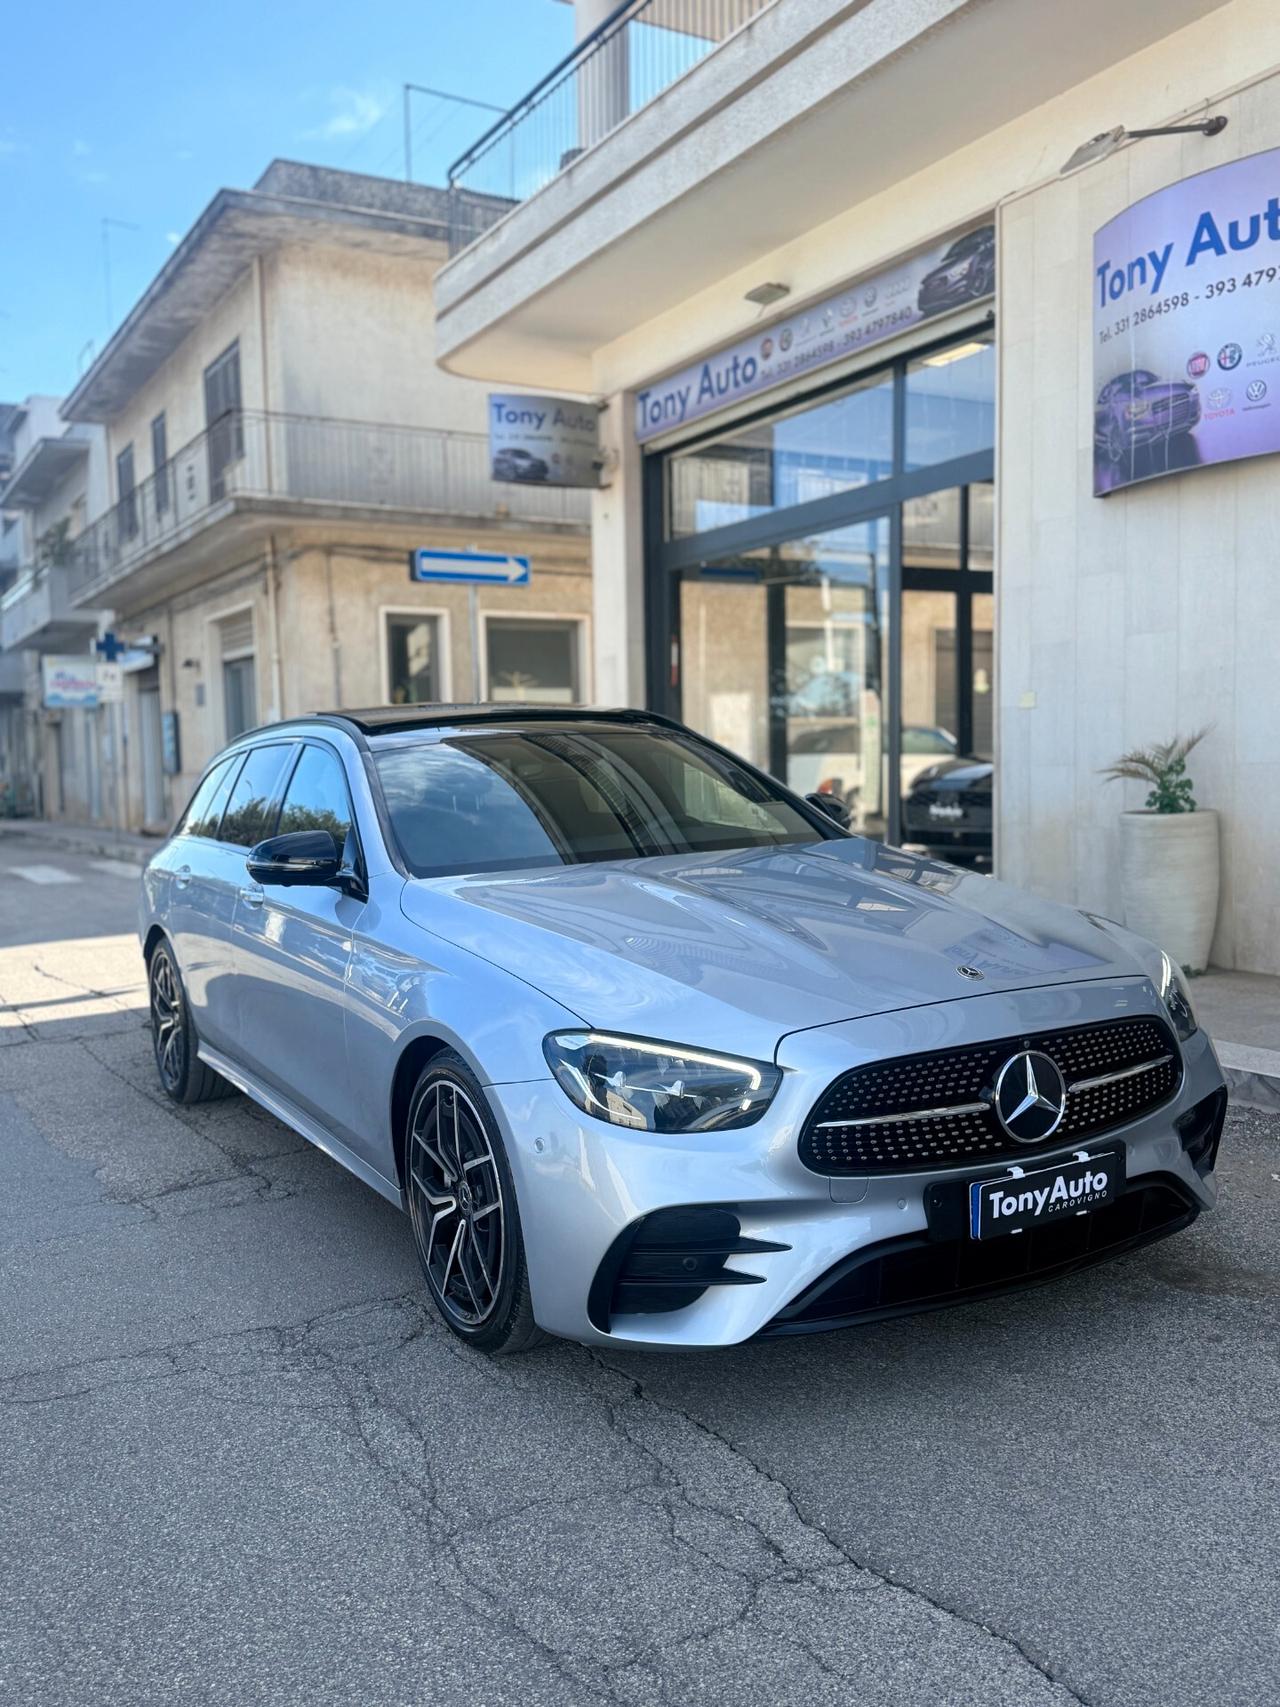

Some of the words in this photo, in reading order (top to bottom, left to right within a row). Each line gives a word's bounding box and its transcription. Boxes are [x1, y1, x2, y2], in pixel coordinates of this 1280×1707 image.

[1097, 242, 1174, 308] Tony
[1114, 316, 1131, 336] 331
[1133, 292, 1189, 327] 2864598
[1205, 278, 1237, 300] 393
[1241, 265, 1280, 288] 479
[638, 385, 691, 428] Tony
[697, 356, 757, 404] Auto
[1203, 408, 1236, 420] TOYOTA
[492, 403, 547, 431] Tony
[552, 407, 596, 432] Auto
[1048, 1189, 1108, 1213] CAROVIGNO
